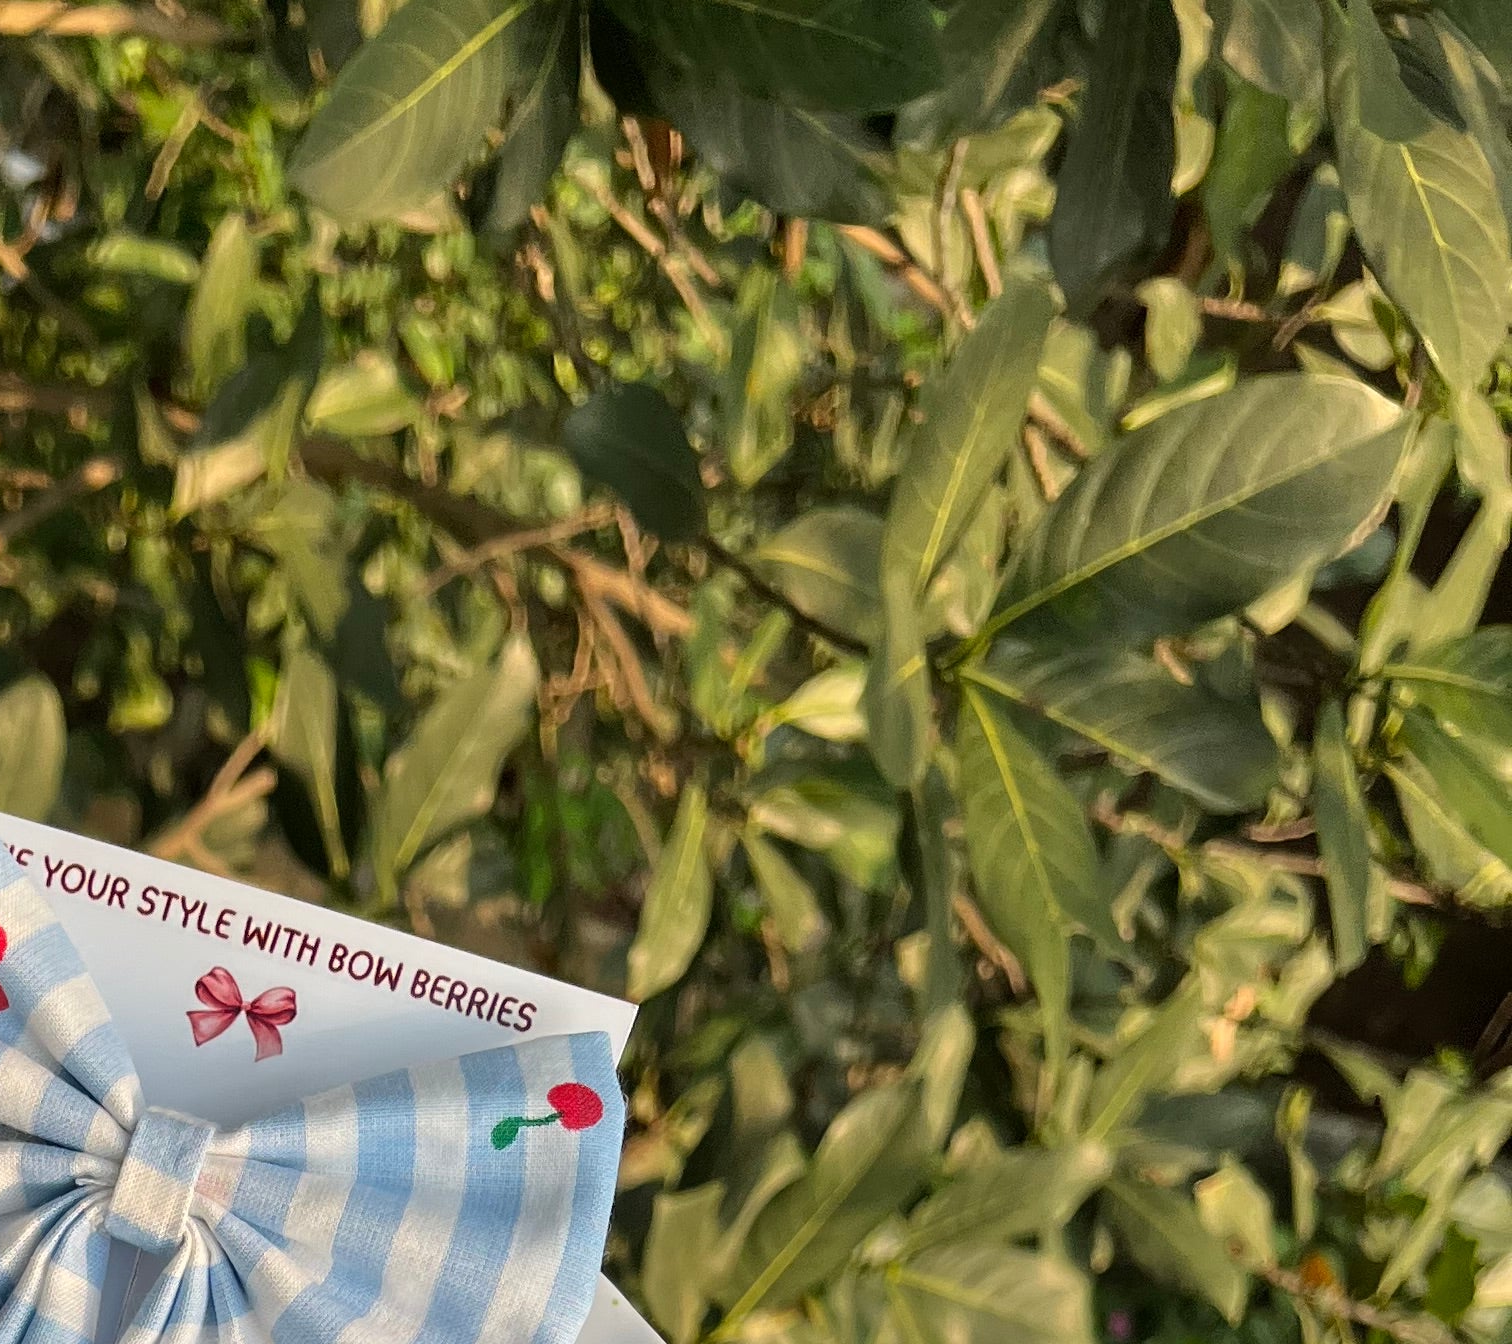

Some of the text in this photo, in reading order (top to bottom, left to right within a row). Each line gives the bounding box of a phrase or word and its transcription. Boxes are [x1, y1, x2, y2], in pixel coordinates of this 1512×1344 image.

[44, 855, 130, 909] YOUR
[136, 886, 236, 939] STYLE
[243, 916, 321, 966] WITH
[328, 943, 403, 991] BOW
[410, 969, 537, 1032] BERRIES
